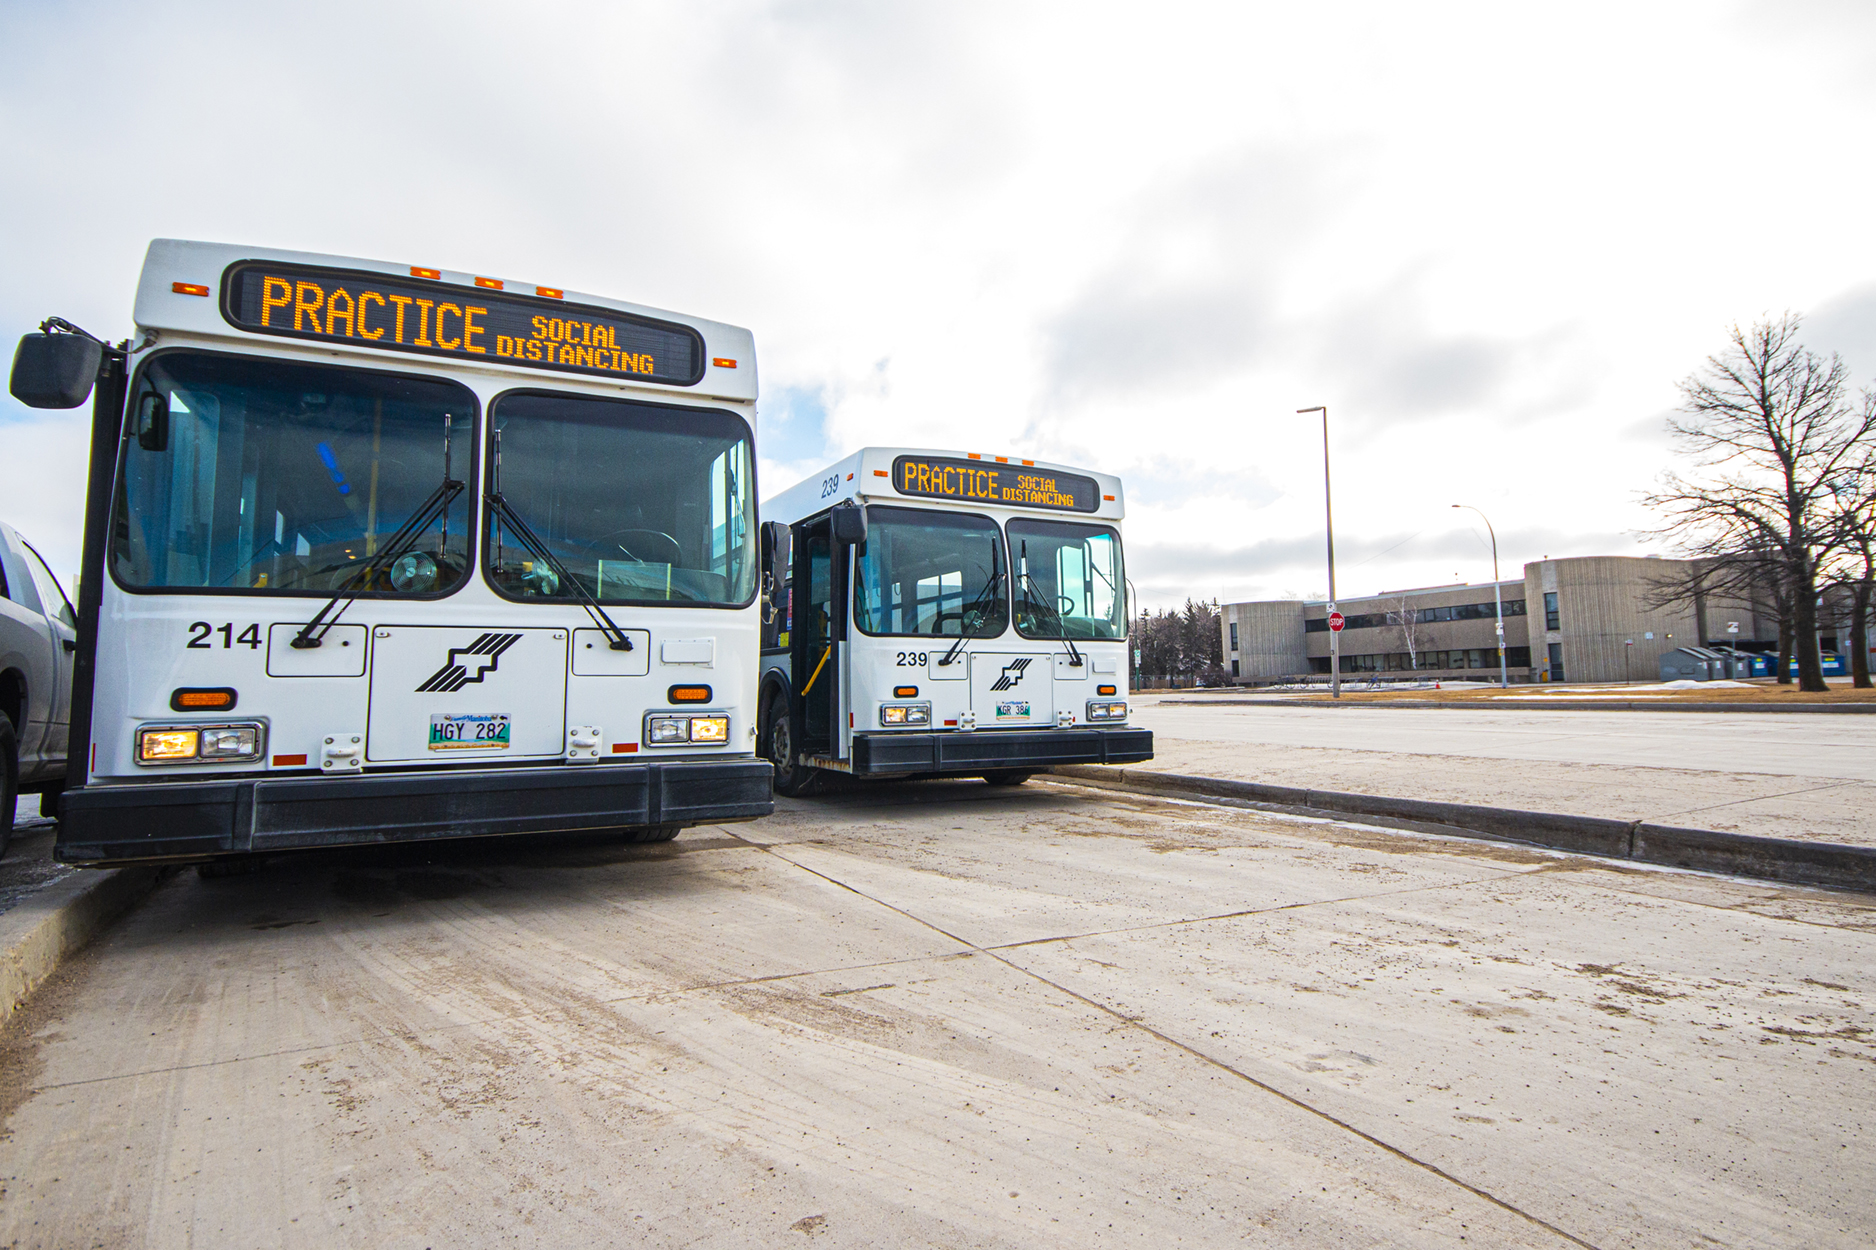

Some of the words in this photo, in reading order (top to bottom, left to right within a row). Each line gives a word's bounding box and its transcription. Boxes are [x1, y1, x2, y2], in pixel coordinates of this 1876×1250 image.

[261, 276, 488, 354] PRACTICE
[531, 315, 621, 350] SOCIAL
[496, 335, 654, 375] DISTANCING
[821, 474, 839, 499] 239
[904, 462, 999, 499] PRACTICE
[1017, 475, 1059, 493] SOCIAL
[1002, 487, 1074, 507] DISTANCING
[1330, 618, 1343, 626] STOP
[186, 621, 263, 650] 214
[896, 651, 928, 667] 239
[997, 704, 1012, 715] KGR
[433, 722, 465, 740] HGY
[476, 722, 506, 740] 282
